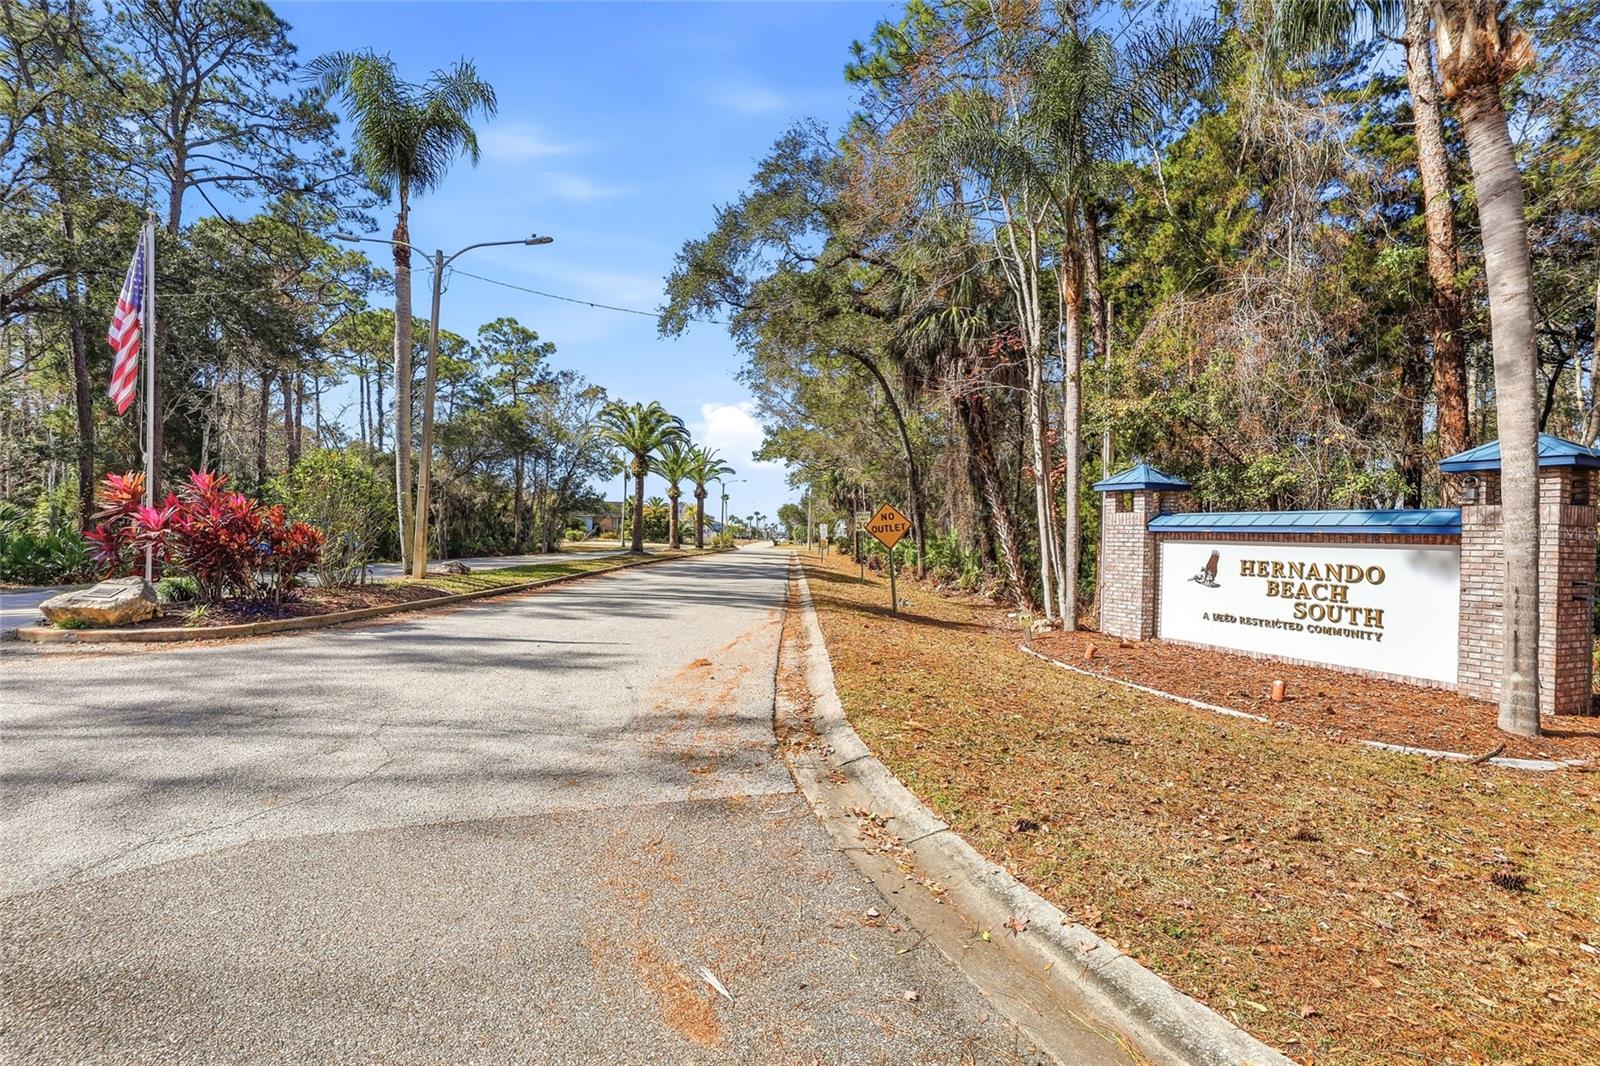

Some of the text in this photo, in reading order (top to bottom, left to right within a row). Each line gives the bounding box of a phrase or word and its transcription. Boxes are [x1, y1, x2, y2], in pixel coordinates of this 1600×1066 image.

[871, 523, 905, 533] OUTLET
[881, 513, 894, 521] NO
[1239, 559, 1386, 585] HERNANDO
[1265, 579, 1349, 604] BEACH
[1202, 611, 1210, 621] A
[1239, 615, 1304, 632] RESTRICTED
[1306, 624, 1384, 643] COMMUNITY
[1293, 601, 1385, 630] SOUTH
